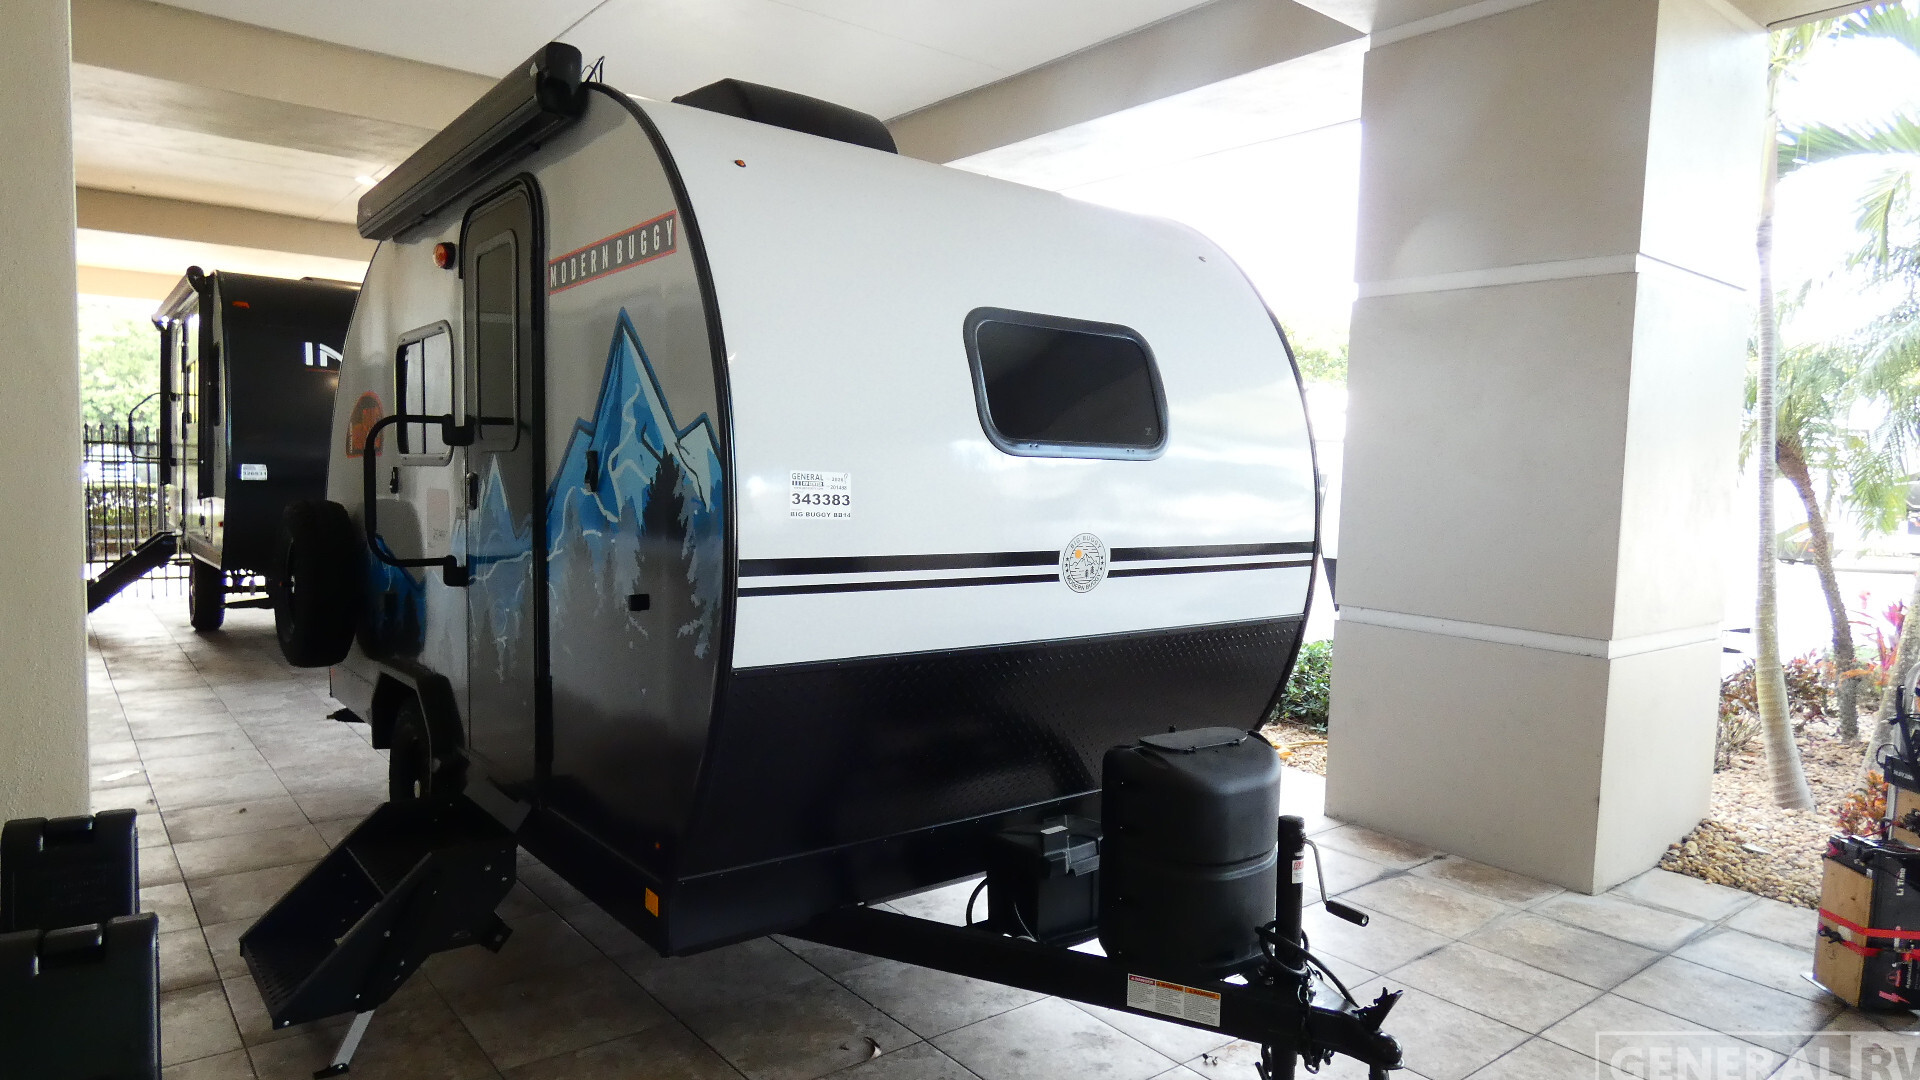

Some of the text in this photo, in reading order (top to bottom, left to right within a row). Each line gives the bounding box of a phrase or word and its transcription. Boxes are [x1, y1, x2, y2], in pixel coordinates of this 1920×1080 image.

[550, 218, 673, 288] MODERN BUGGY
[791, 472, 824, 481] GENERAL
[791, 492, 850, 506] 343383
